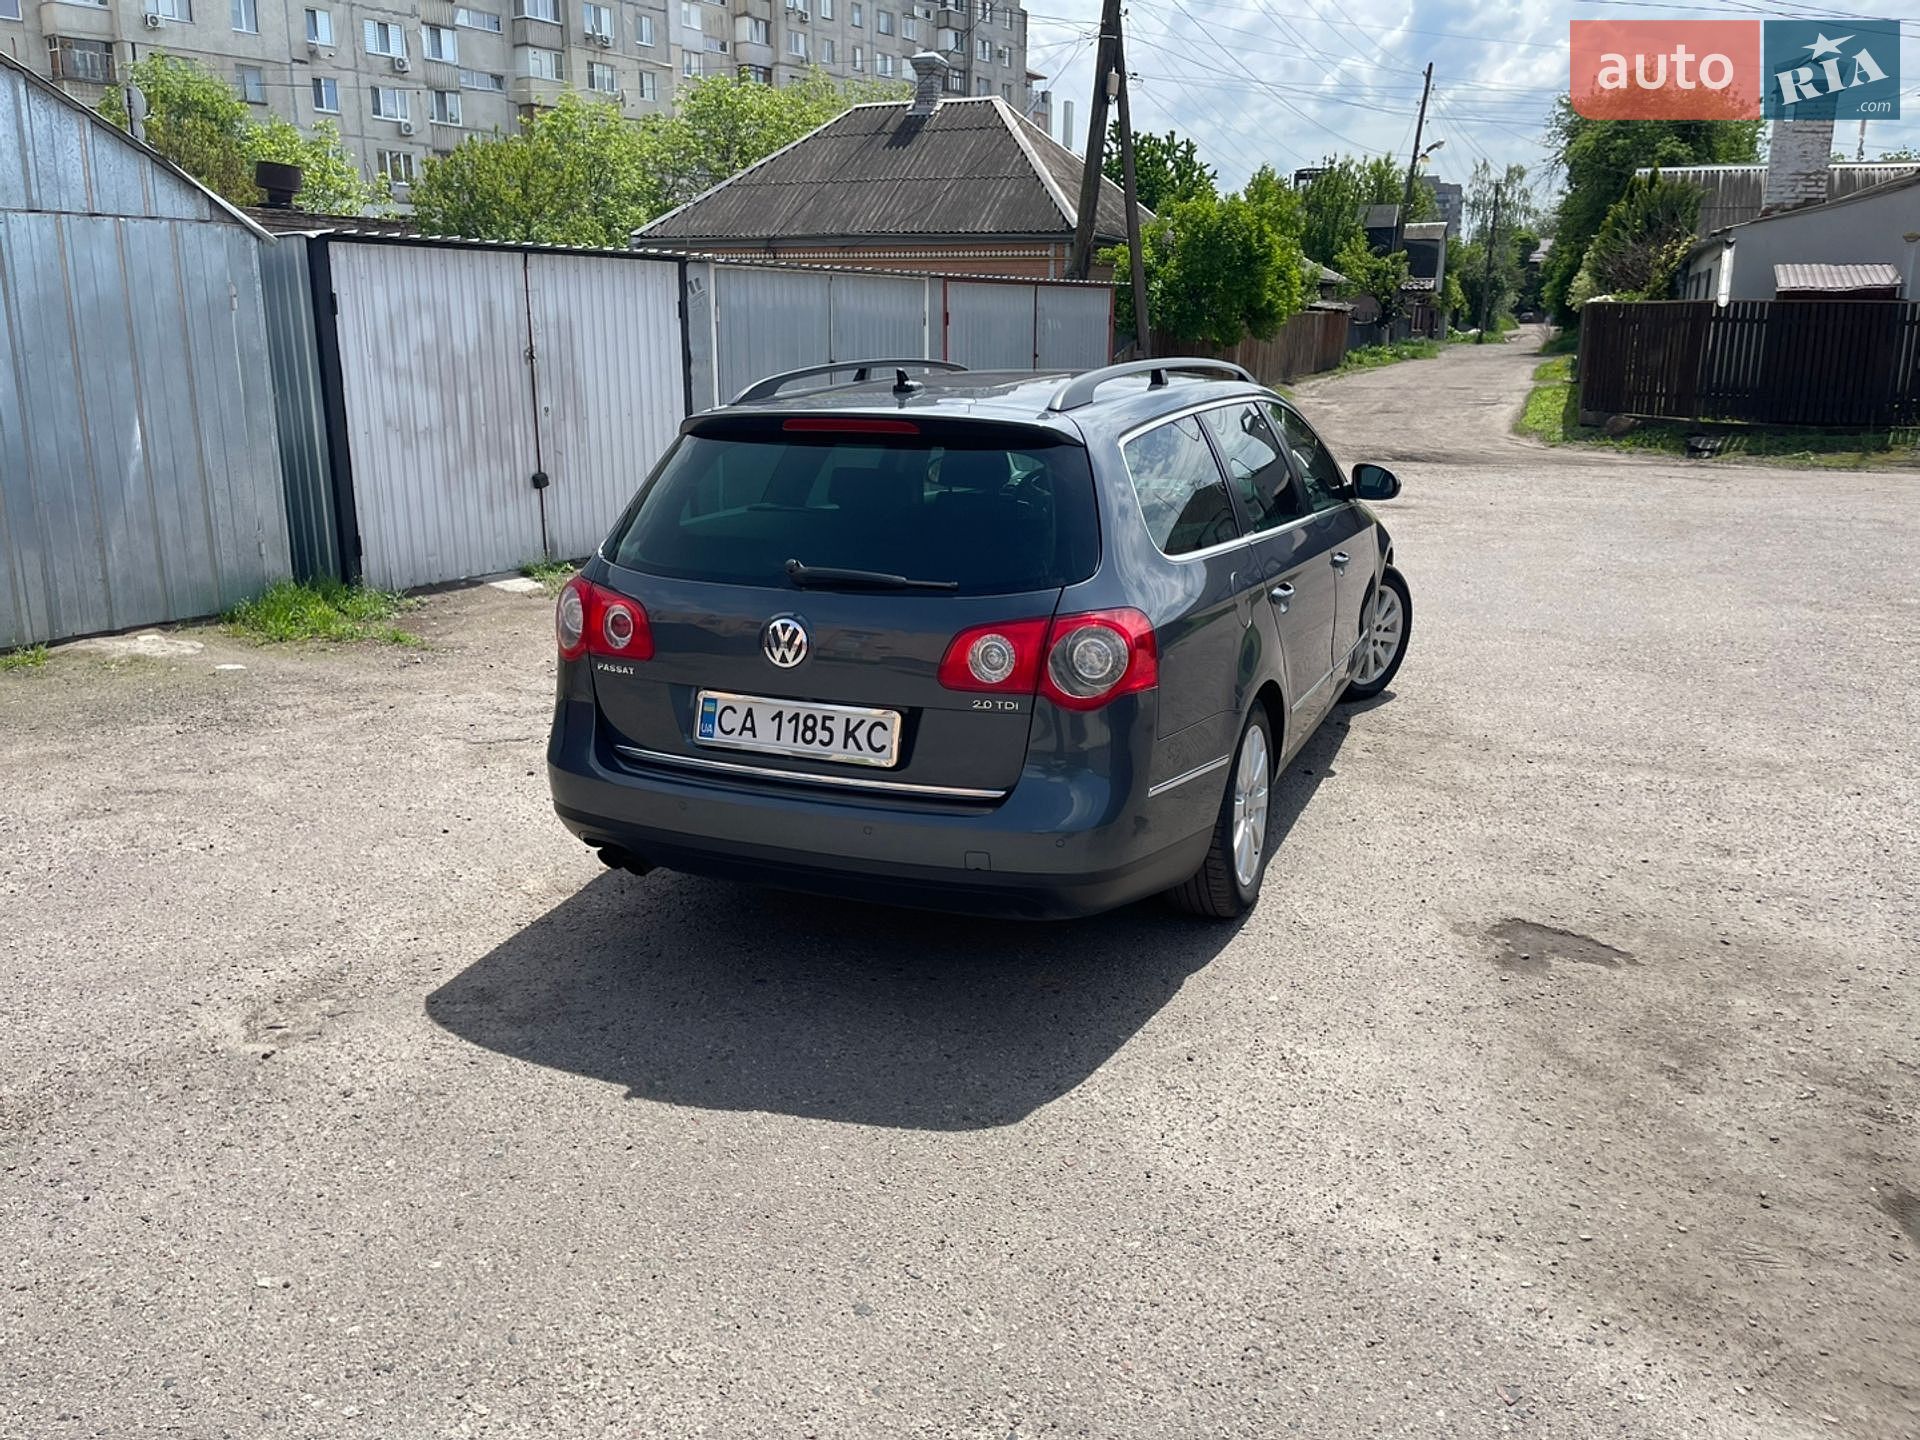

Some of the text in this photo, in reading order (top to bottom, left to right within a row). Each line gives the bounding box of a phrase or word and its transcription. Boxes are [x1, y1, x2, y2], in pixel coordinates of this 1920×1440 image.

[764, 618, 808, 668] VW
[597, 662, 634, 675] PASSAT
[995, 700, 1019, 711] TDI
[701, 722, 713, 734] UA
[717, 705, 888, 753] CA 1185 KC
